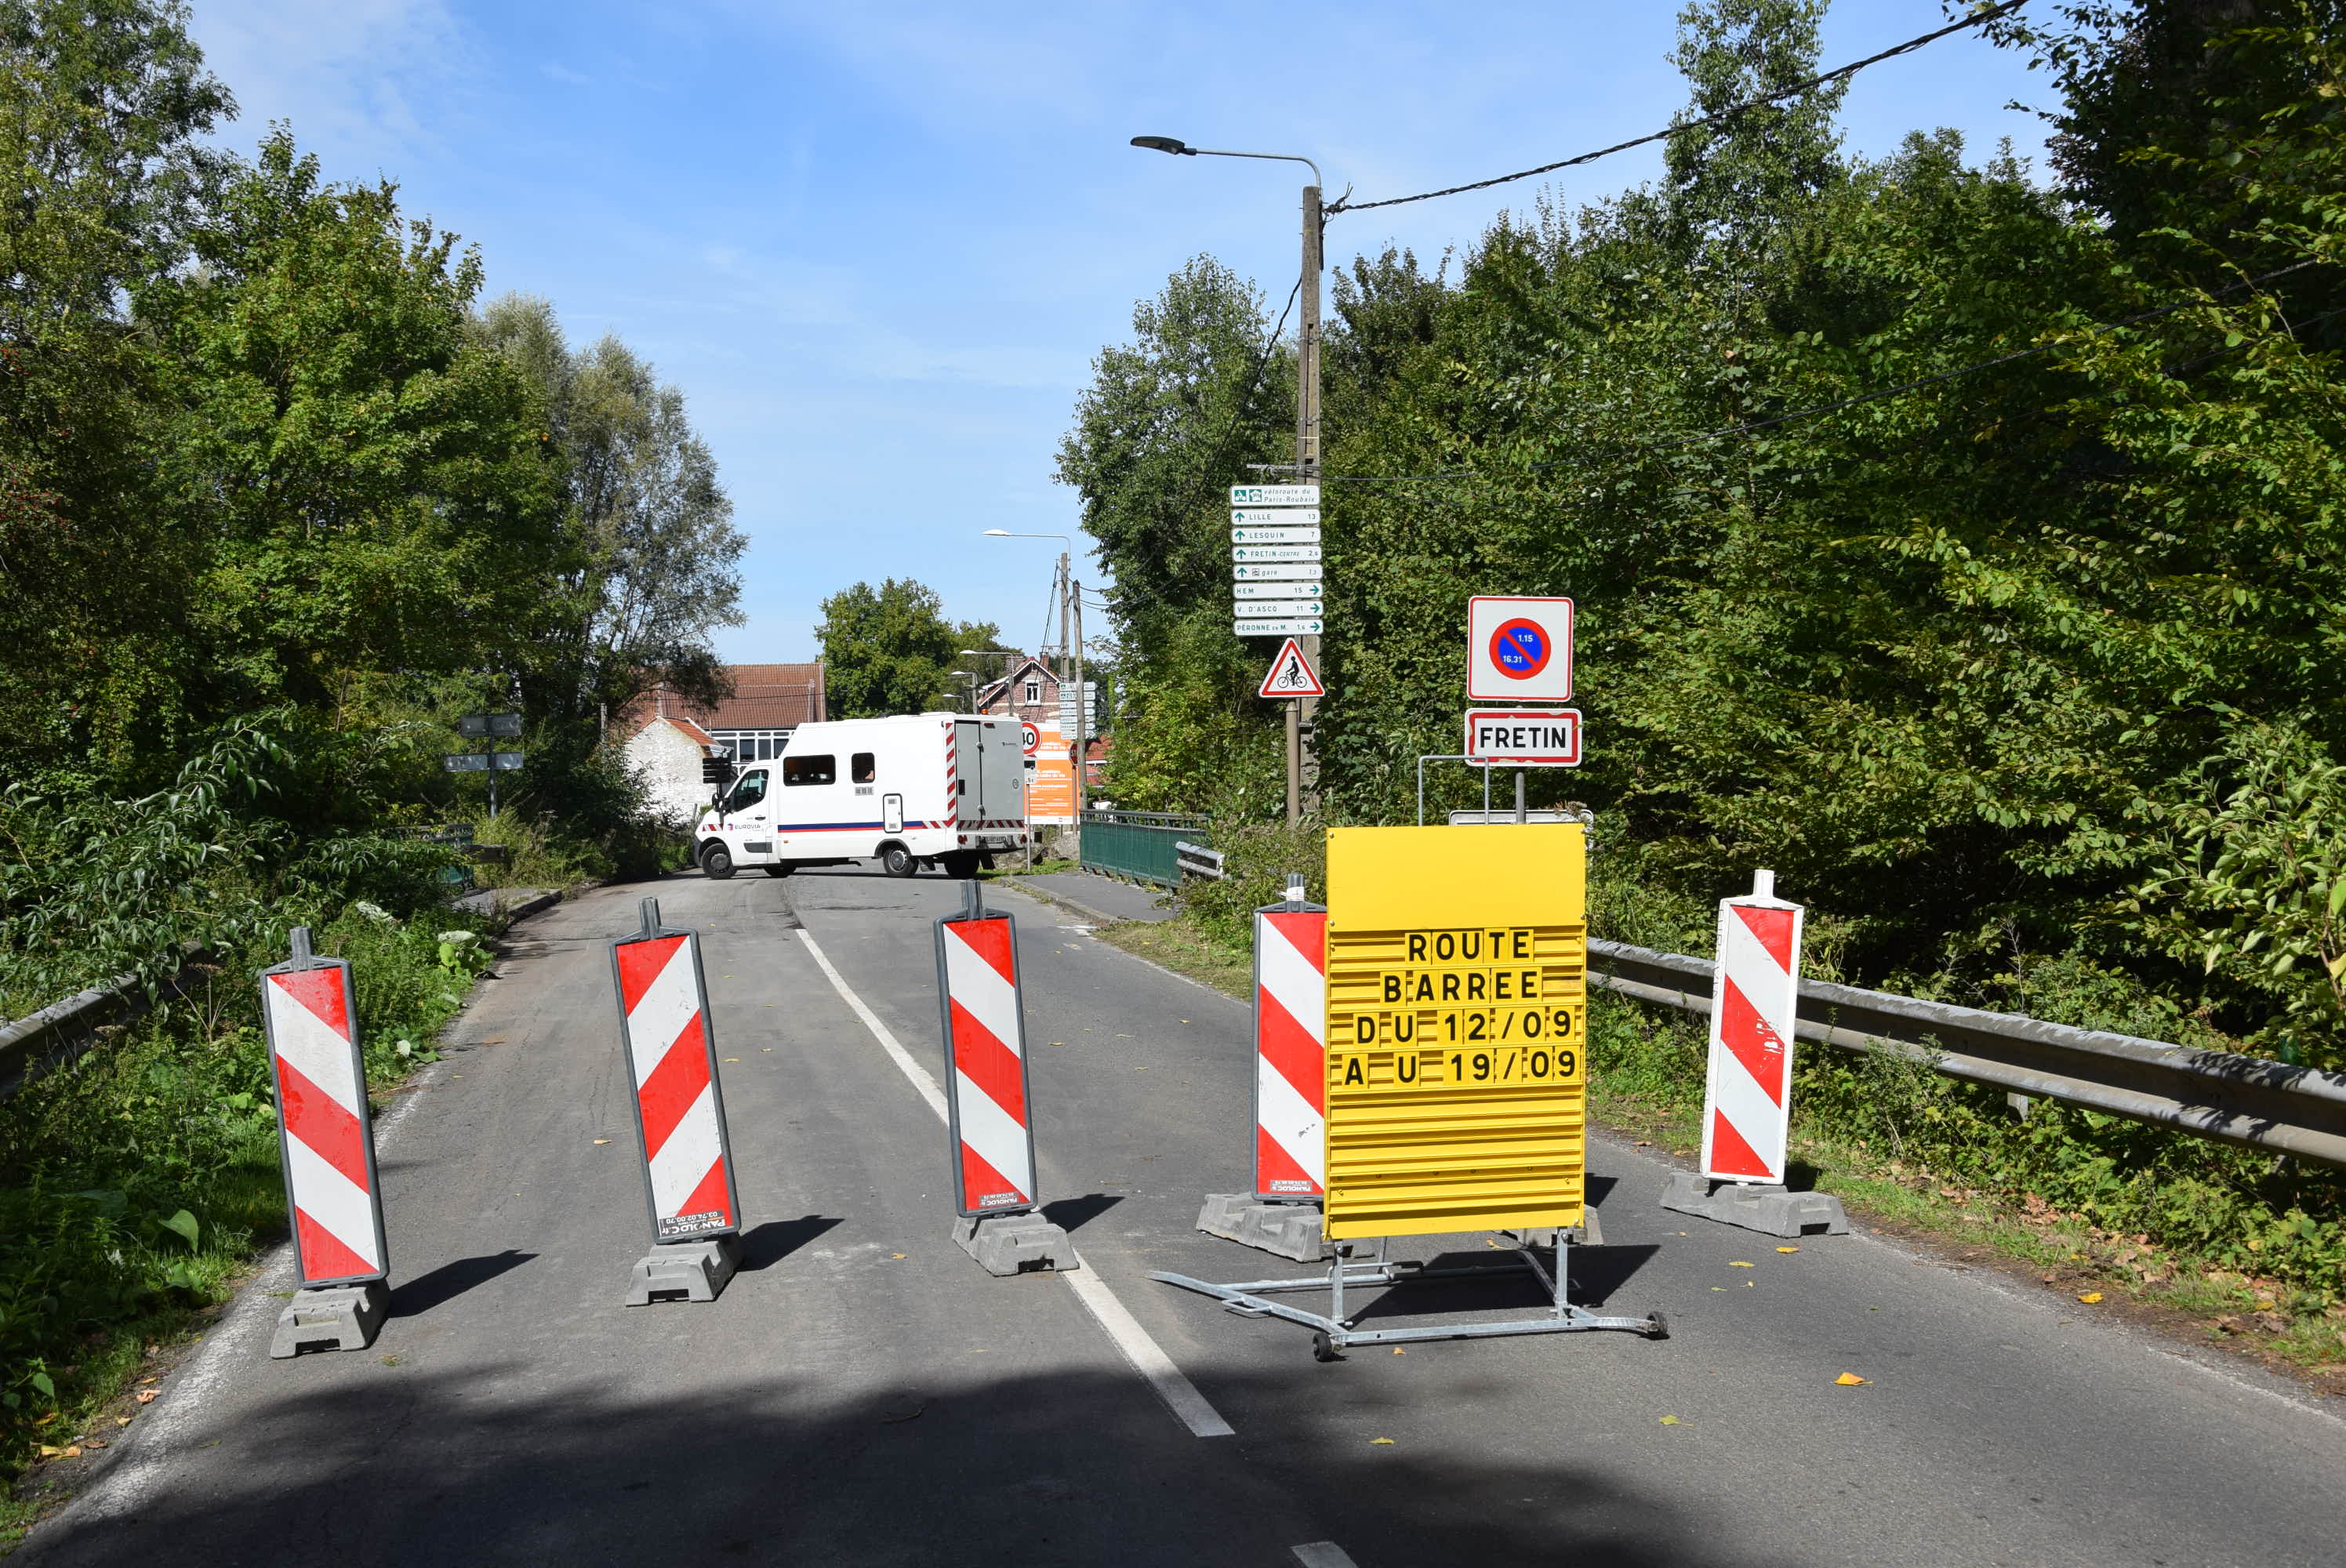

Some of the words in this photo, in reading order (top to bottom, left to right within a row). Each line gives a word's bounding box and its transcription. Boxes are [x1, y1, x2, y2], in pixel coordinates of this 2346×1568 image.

[1518, 634, 1534, 643] 1.15
[1480, 727, 1567, 749] FRETIN
[1408, 931, 1530, 962] ROUTE
[1384, 971, 1538, 1003] BARREE
[1356, 1014, 1414, 1044] DU
[1445, 1010, 1571, 1042] 12/09
[1344, 1054, 1416, 1086] AU
[1451, 1050, 1575, 1082] 19/09
